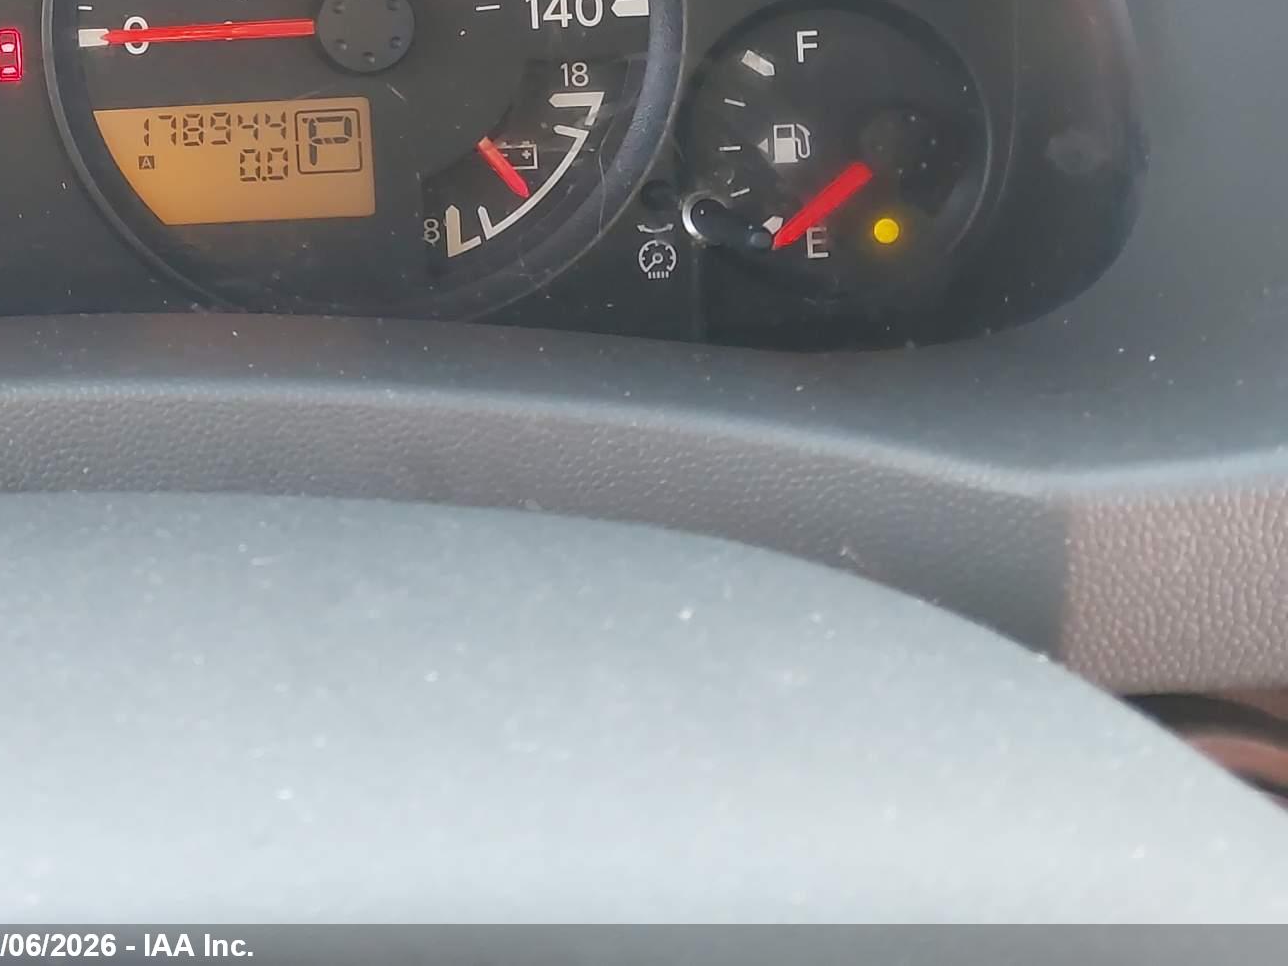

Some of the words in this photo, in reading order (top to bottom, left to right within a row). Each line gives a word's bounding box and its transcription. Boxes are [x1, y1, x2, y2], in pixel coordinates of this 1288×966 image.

[123, 16, 149, 54] 0
[796, 30, 819, 63] F
[560, 63, 589, 86] 18
[143, 112, 287, 146] 178944
[302, 116, 352, 166] P
[240, 147, 288, 181] 0.0
[806, 227, 829, 259] E
